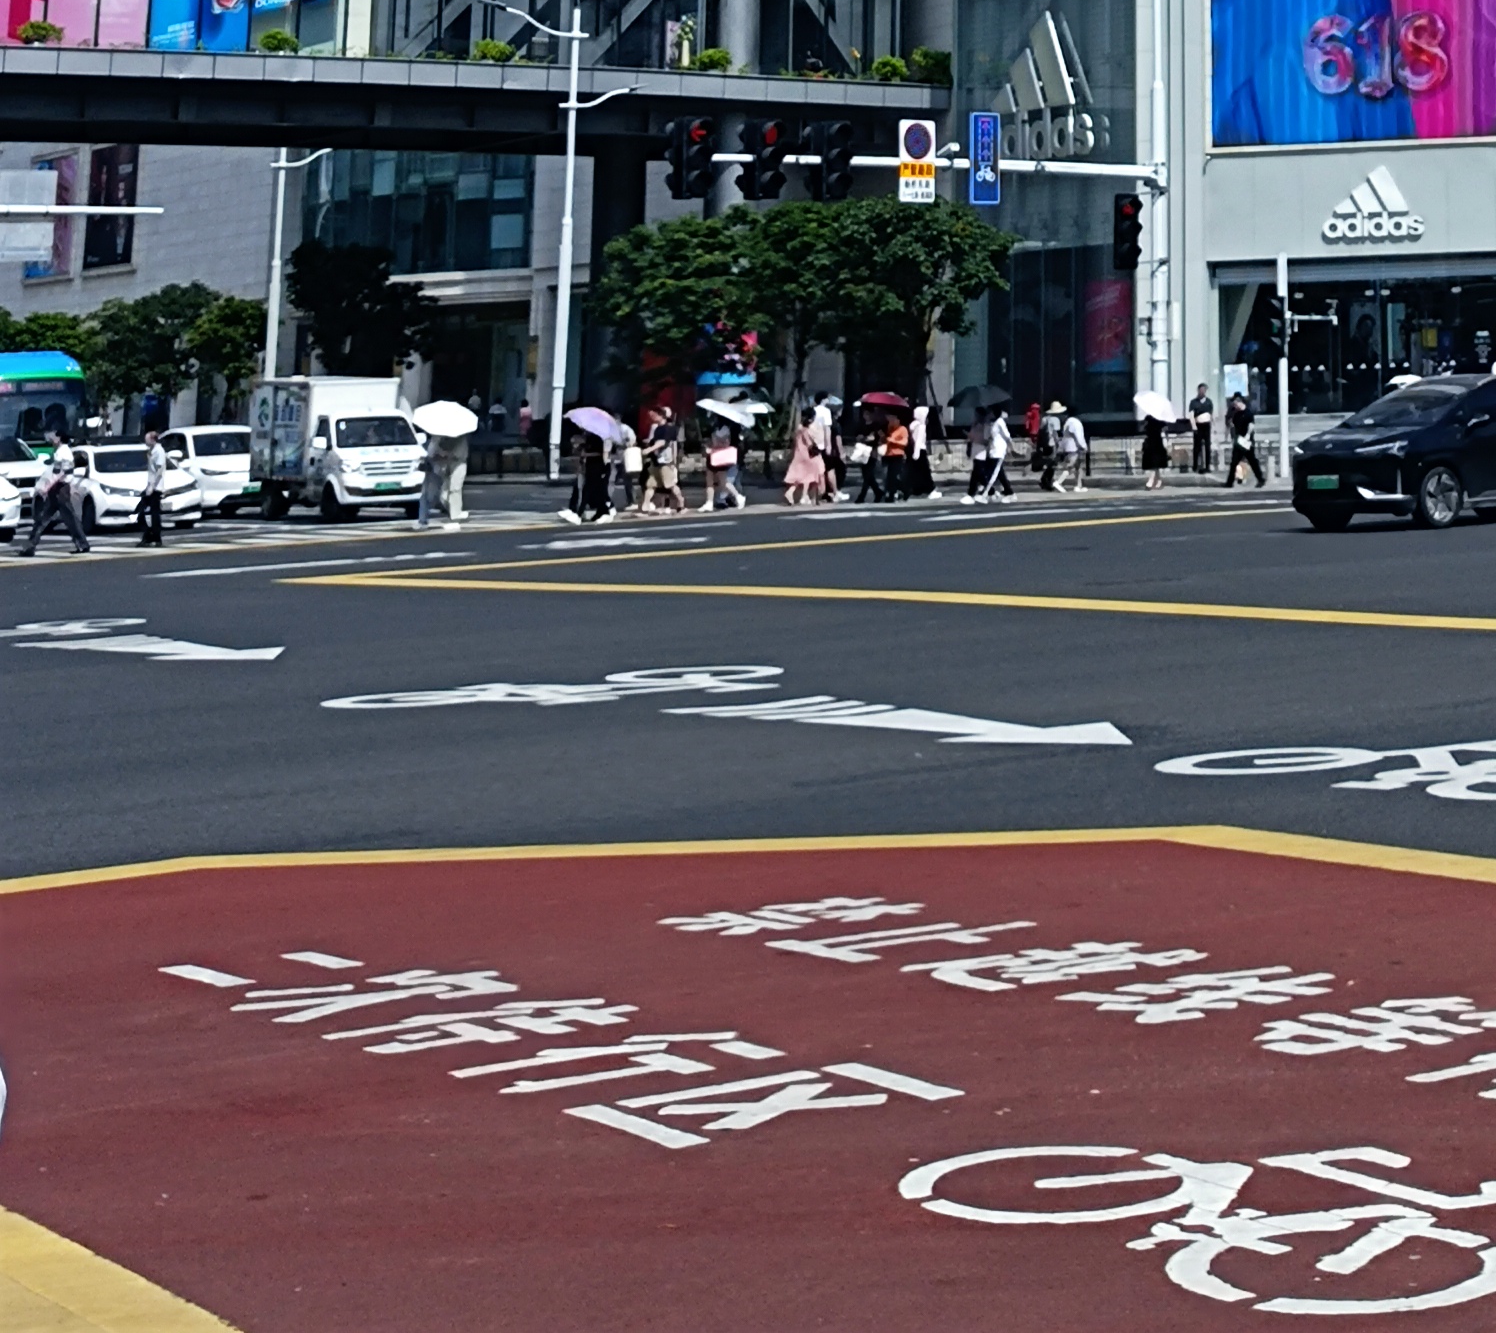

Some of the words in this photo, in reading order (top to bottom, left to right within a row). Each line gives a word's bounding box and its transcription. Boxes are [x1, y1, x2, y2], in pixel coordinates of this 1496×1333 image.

[1303, 11, 1448, 97] 618
[1000, 108, 1094, 159] didas
[1322, 210, 1425, 240] adidas
